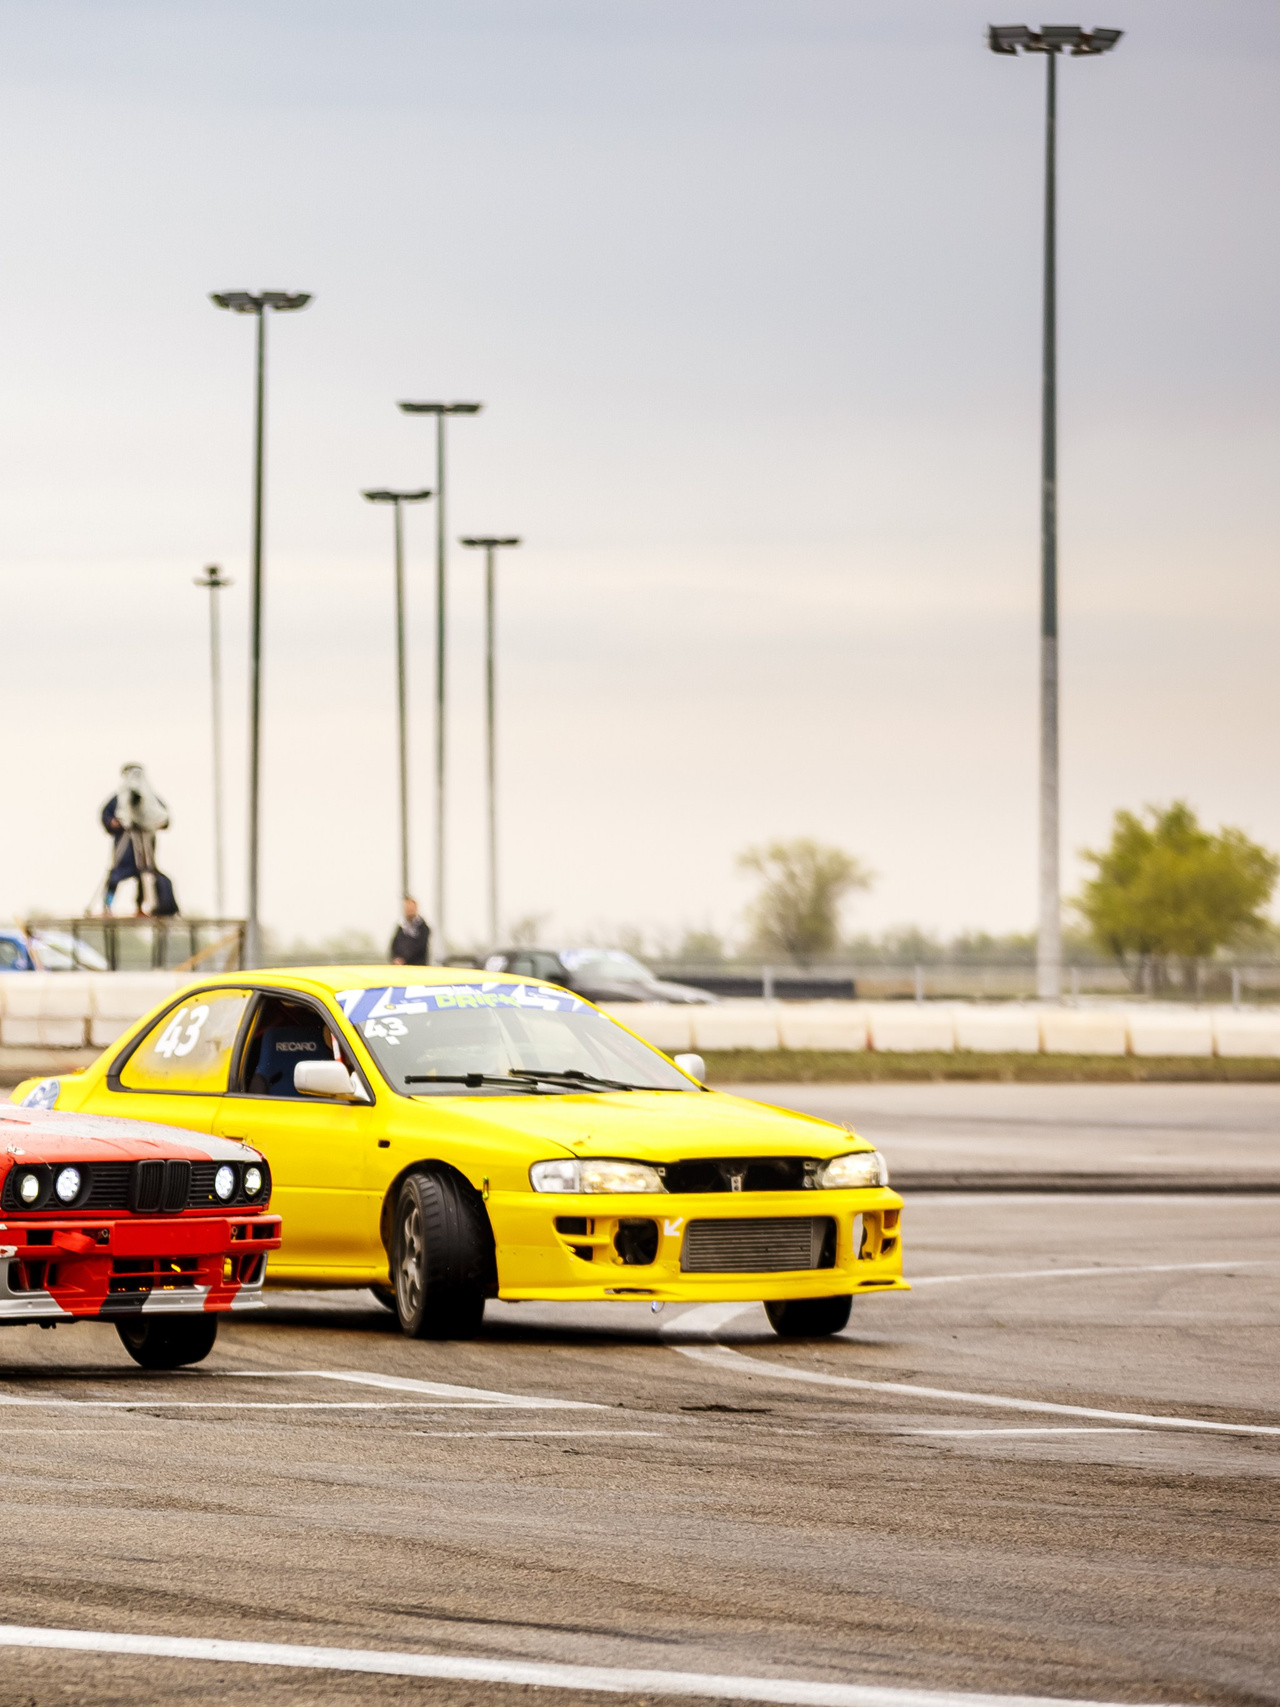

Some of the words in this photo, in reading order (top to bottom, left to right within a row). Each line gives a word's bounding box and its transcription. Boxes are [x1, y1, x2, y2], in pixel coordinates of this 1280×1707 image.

[154, 1004, 210, 1058] 43
[363, 1017, 409, 1040] 43
[275, 1041, 317, 1052] RECARO
